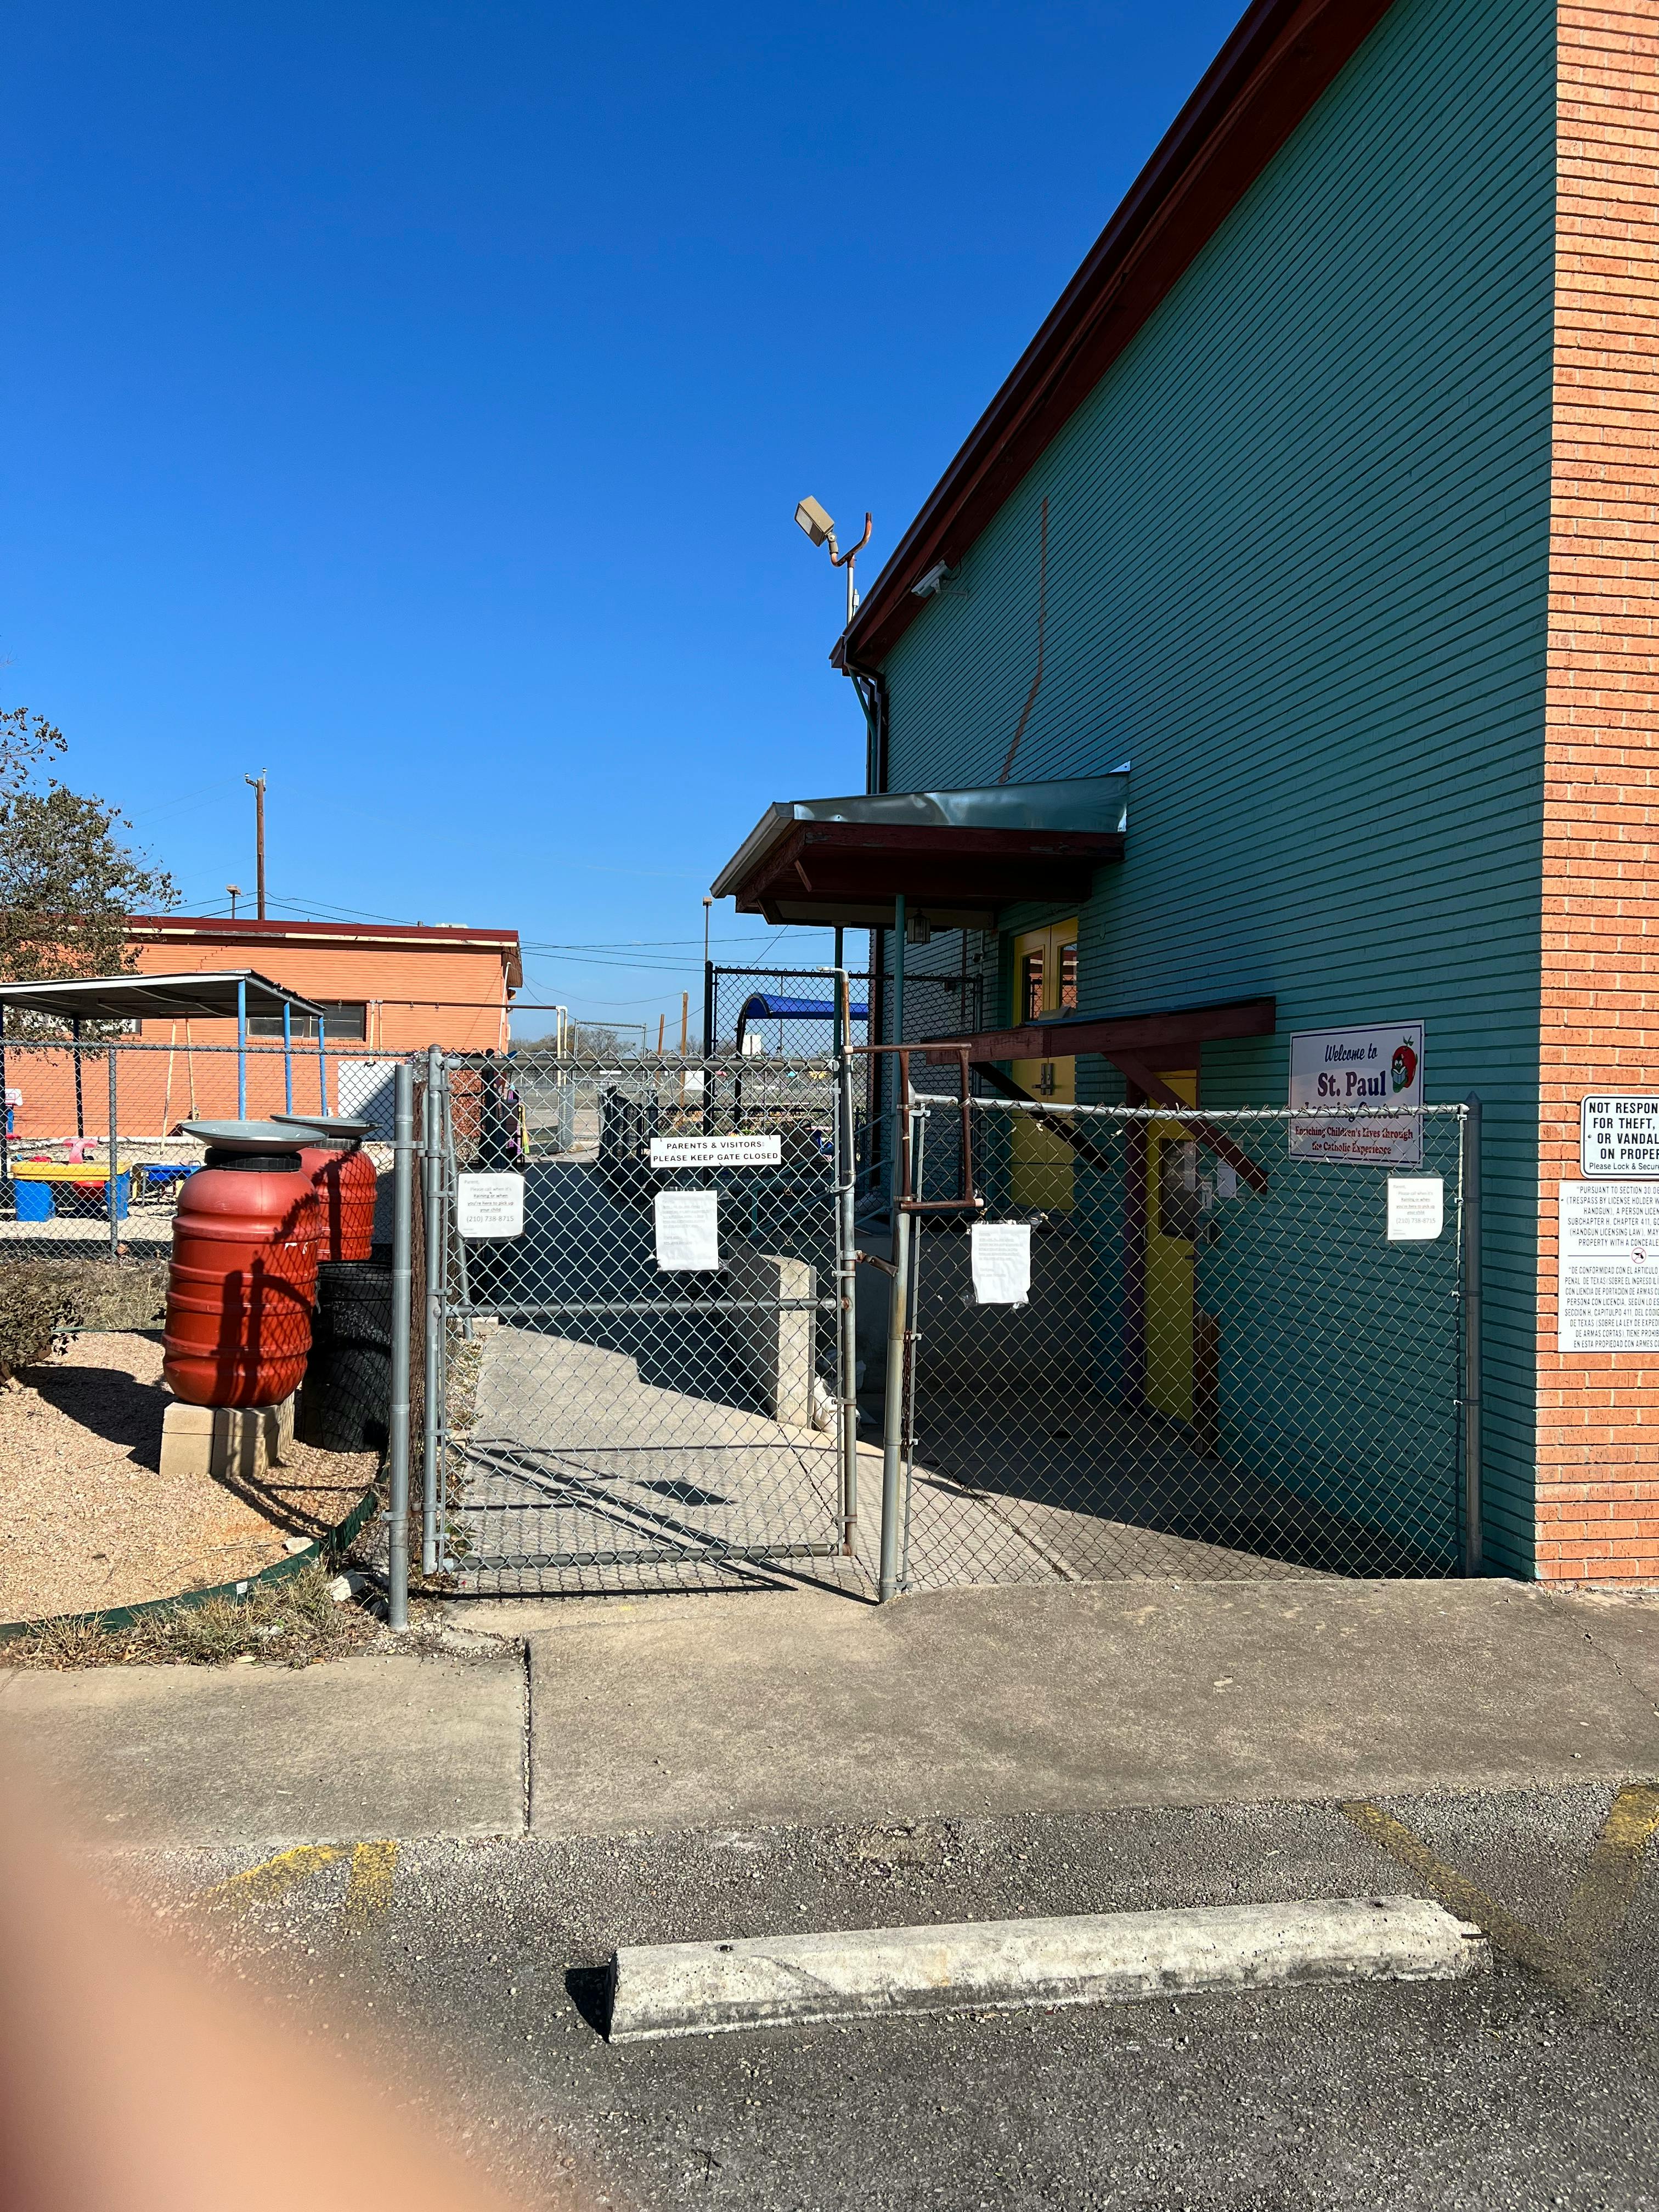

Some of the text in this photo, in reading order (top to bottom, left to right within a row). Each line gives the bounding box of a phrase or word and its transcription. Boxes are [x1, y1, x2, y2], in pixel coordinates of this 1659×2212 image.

[1325, 1043, 1378, 1062] Welcome to
[1318, 1070, 1386, 1097] St. Paul
[1589, 1102, 1658, 1114] NOT RESPON
[1593, 1118, 1655, 1130] FOR THEFT,
[1295, 1126, 1325, 1138] Enriching
[1327, 1126, 1361, 1137] Children's
[1362, 1127, 1380, 1138] Lives
[1598, 1133, 1659, 1144] OR VANDAL
[1312, 1142, 1322, 1150] the
[1323, 1142, 1350, 1153] Catholic
[1600, 1148, 1615, 1159] ON
[1566, 1197, 1598, 1205] (TRESPASS
[1570, 1228, 1599, 1237] (HANDGUN
